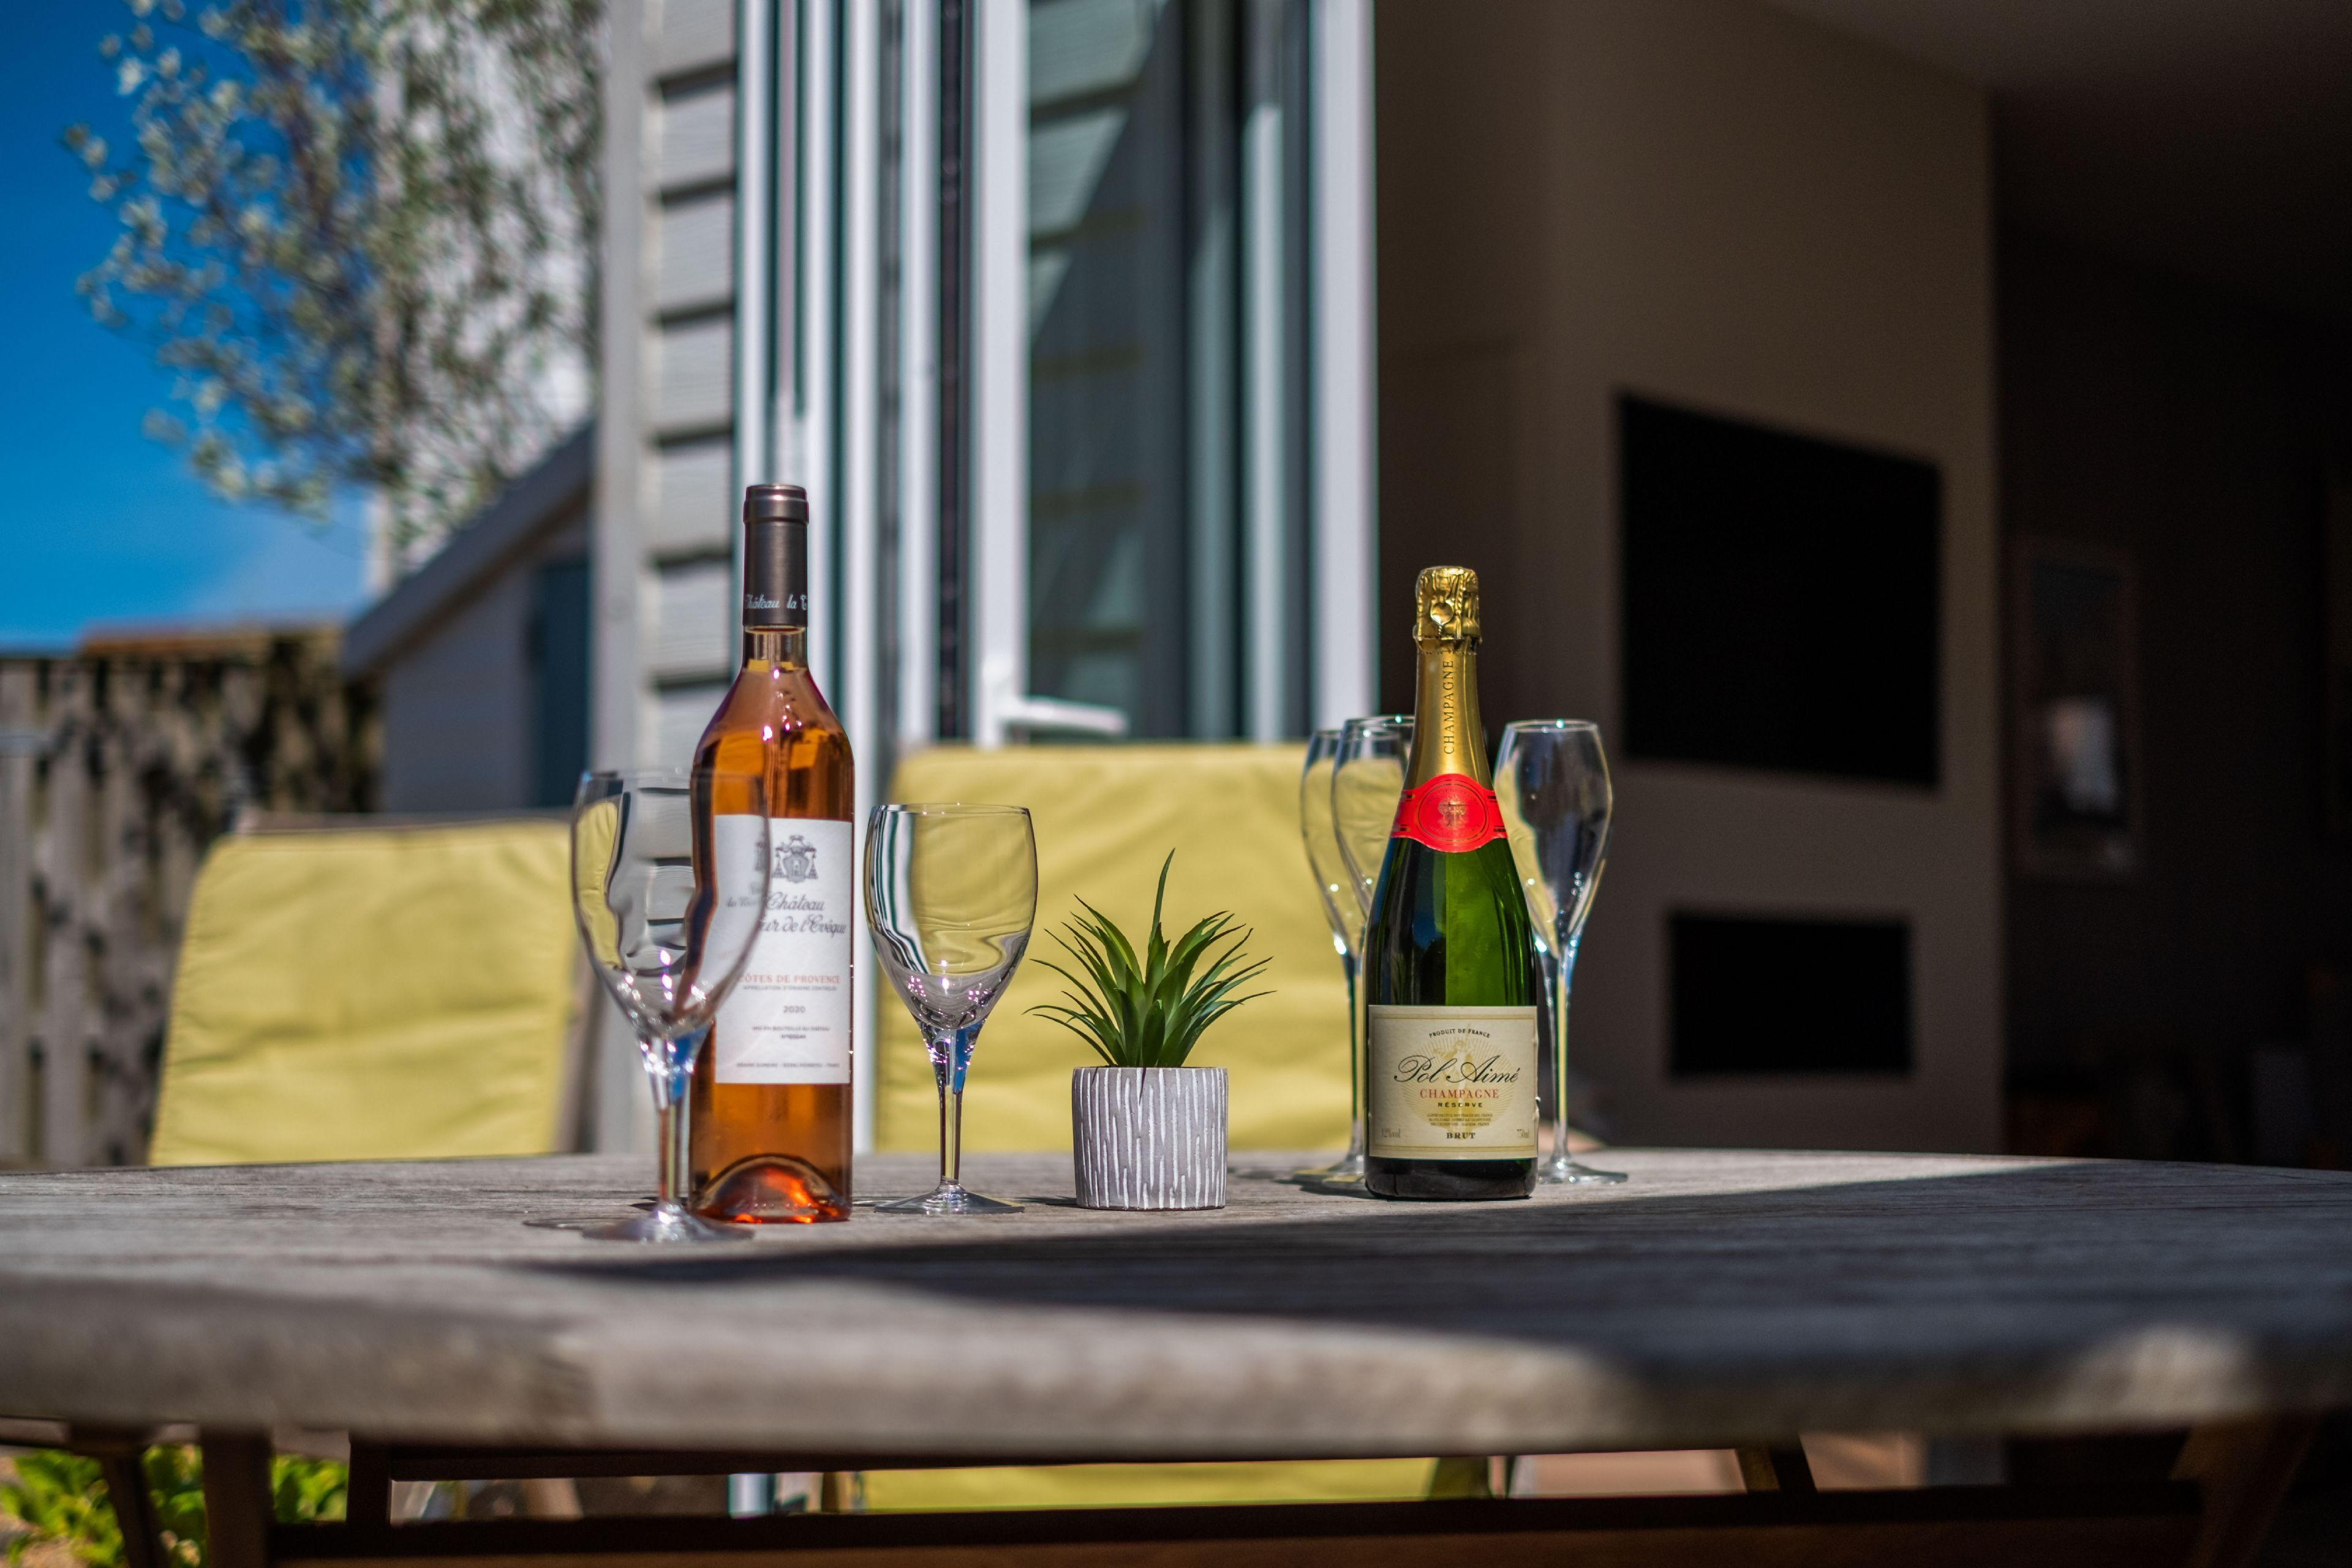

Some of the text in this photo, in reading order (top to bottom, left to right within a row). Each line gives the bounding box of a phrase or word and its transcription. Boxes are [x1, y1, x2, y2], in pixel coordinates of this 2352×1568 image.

[786, 593, 797, 609] la
[1443, 660, 1455, 755] CHAMPAGNE
[766, 891, 825, 911] Château
[783, 916, 798, 932] de
[776, 974, 790, 984] DE
[1429, 1028, 1456, 1038] PRODUIT
[1468, 1028, 1490, 1038] FRANCE
[1393, 1055, 1520, 1084] Pol Aimé
[1420, 1089, 1499, 1099] CHAMPAGNE
